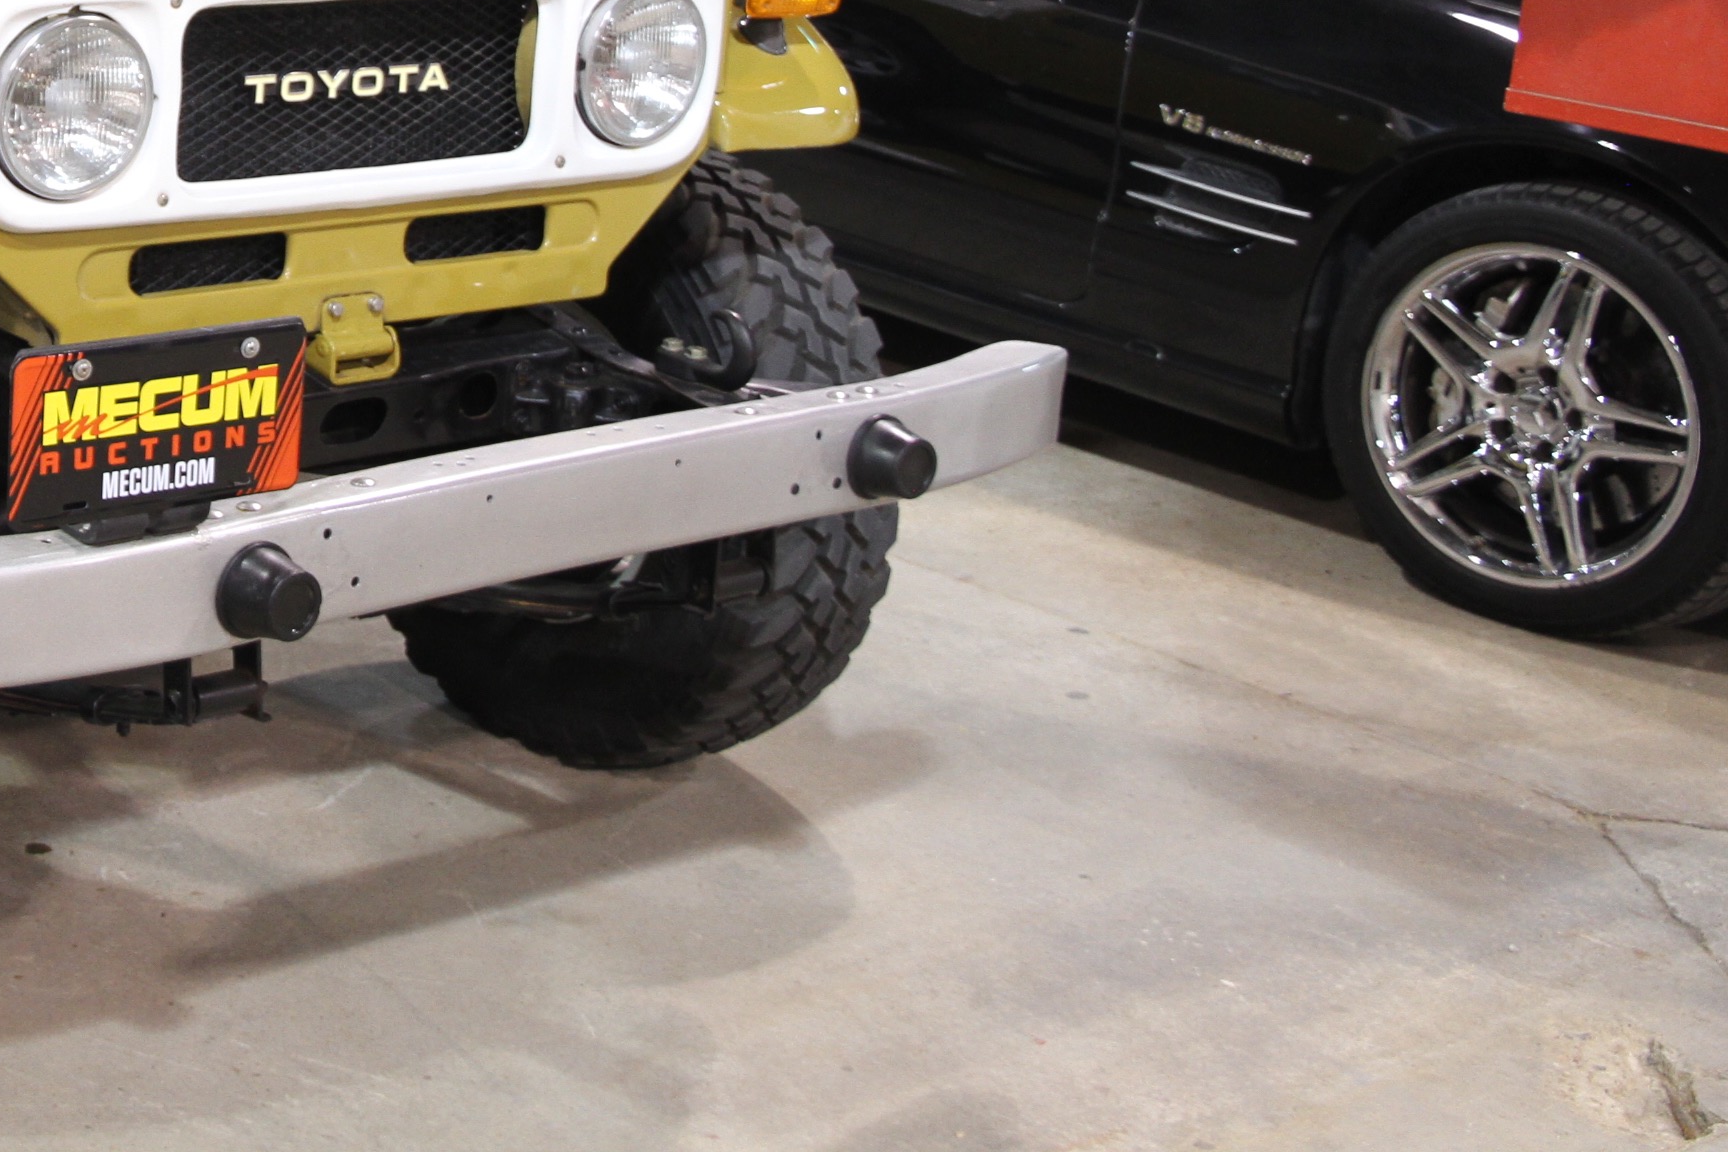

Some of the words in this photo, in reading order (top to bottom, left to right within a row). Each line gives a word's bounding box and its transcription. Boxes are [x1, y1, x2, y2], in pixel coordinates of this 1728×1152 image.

[244, 62, 449, 104] TOYOTA
[42, 363, 279, 447] MECUM
[39, 419, 277, 476] AUCTIONS
[101, 456, 216, 500] MECUM.COM
